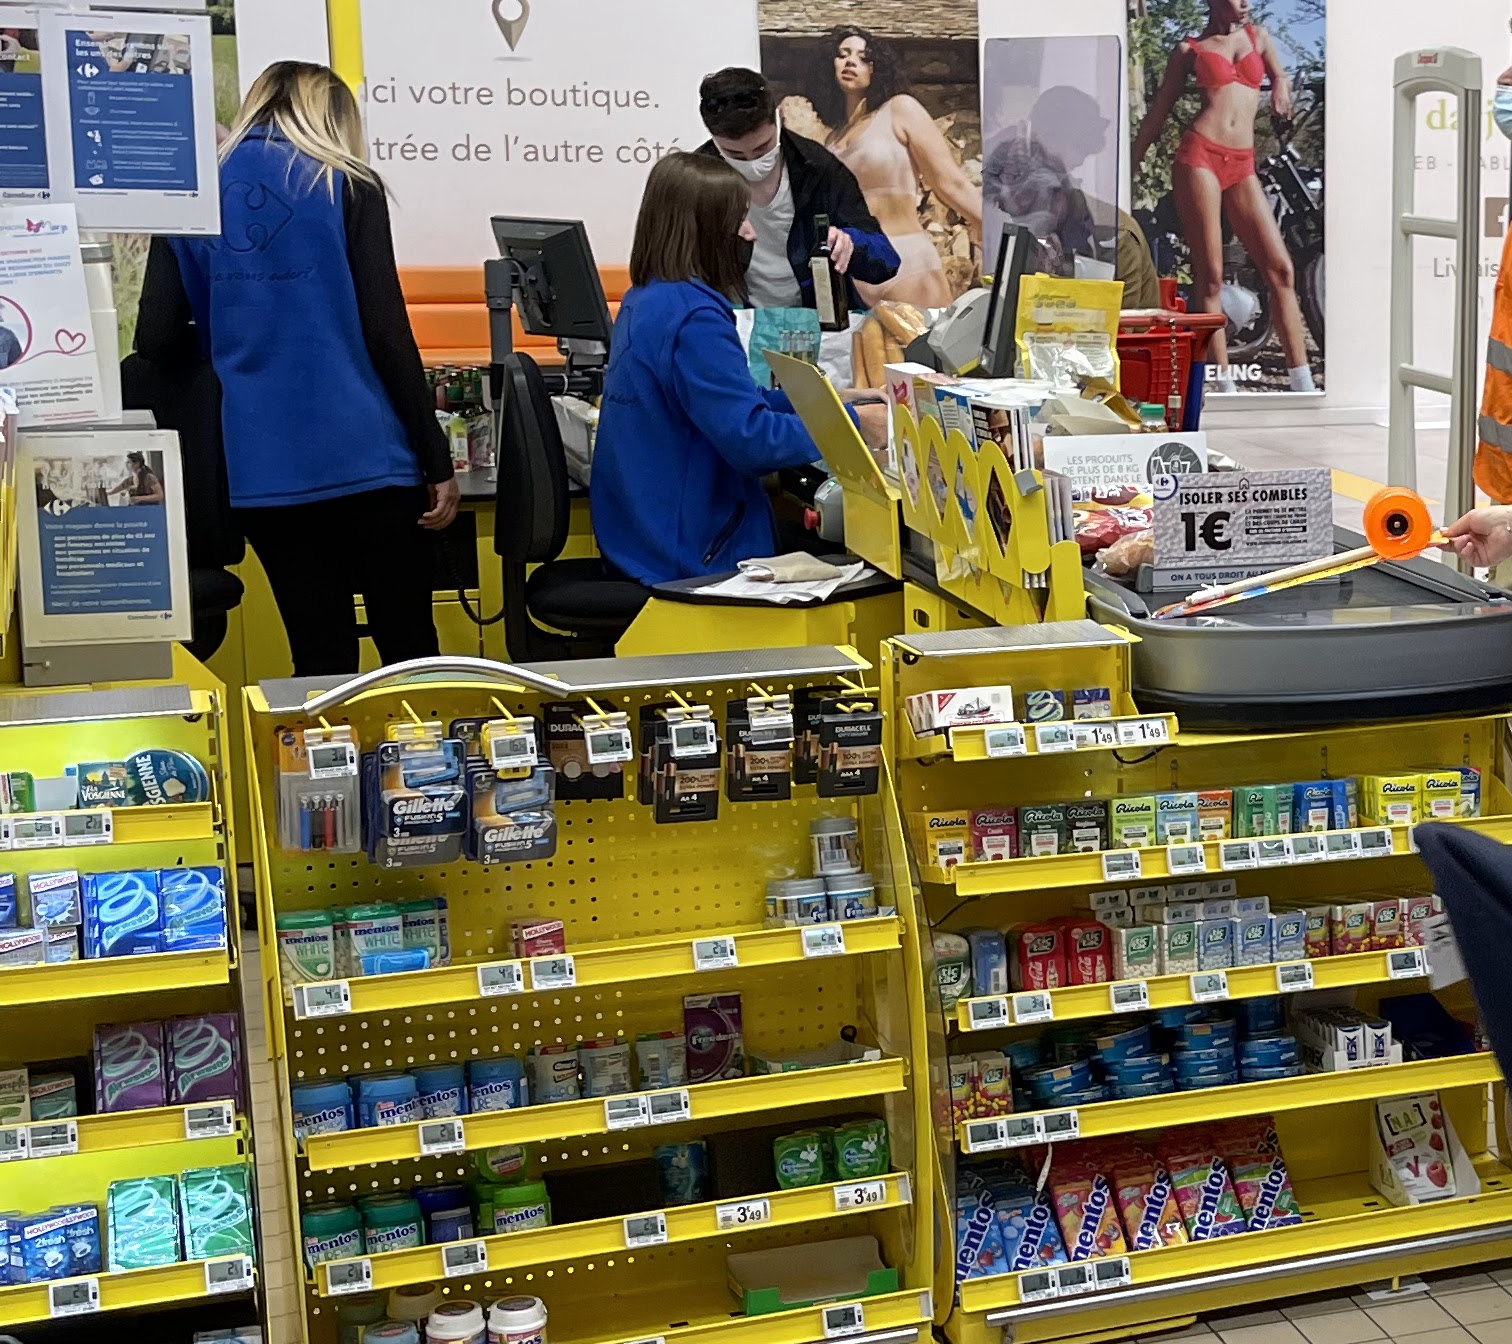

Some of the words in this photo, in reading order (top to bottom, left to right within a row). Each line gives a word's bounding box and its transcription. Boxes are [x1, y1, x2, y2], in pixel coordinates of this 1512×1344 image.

[363, 76, 397, 103] Ici
[408, 81, 495, 106] votre
[506, 78, 660, 116] boutique.
[372, 134, 439, 161] trée
[451, 133, 492, 161] de
[1413, 155, 1437, 171] EB
[1204, 363, 1262, 382] ELING
[1067, 455, 1083, 465] LES
[1086, 454, 1133, 464] PRODUITS
[1062, 466, 1074, 475] DE
[1077, 465, 1101, 475] PLUS
[1102, 464, 1115, 474] DE
[1117, 464, 1124, 474] 8
[1126, 464, 1140, 473] KG
[1072, 475, 1101, 485] STENT
[1104, 474, 1129, 483] DANS
[1131, 473, 1142, 483] LE
[1179, 491, 1223, 505] ISOLER
[1228, 490, 1248, 503] SES
[1252, 488, 1308, 502] COMBLES
[1181, 511, 1232, 552] 1€
[1170, 574, 1184, 582] ON
[1194, 572, 1217, 580] TOUS
[1218, 571, 1244, 579] DROIT
[550, 723, 584, 733] DURAC
[834, 724, 872, 733] DURACELL
[762, 774, 769, 782] 4
[854, 769, 861, 777] 4
[135, 754, 167, 806] SGIENNE
[1426, 778, 1459, 789] Ricola
[1382, 782, 1416, 793] Ricola
[690, 794, 698, 802] 4
[392, 796, 456, 815] Gillette
[1115, 803, 1152, 814] Ricola
[1159, 800, 1195, 811] Ricola
[1025, 810, 1063, 824] Ricola
[1066, 806, 1106, 819] Ricola
[929, 817, 967, 828] Ricola
[976, 814, 1015, 827] Ricola
[392, 827, 400, 838] 3
[484, 824, 545, 844] Gillette
[385, 857, 393, 868] 3
[484, 854, 491, 865] 3
[33, 874, 76, 891] HOLLYWOOD
[403, 917, 436, 928] entos
[354, 924, 400, 936] mentos
[524, 921, 563, 938] HOLLYWOOD
[285, 934, 329, 945] mentos
[472, 1080, 512, 1099] entos
[417, 1087, 460, 1107] entos
[379, 1102, 418, 1120] ment
[496, 1204, 546, 1227] mentos
[737, 1205, 762, 1224] 3€49
[367, 1222, 418, 1246] mentos
[35, 1235, 66, 1249] 2fresh
[307, 1229, 360, 1256] mentos
